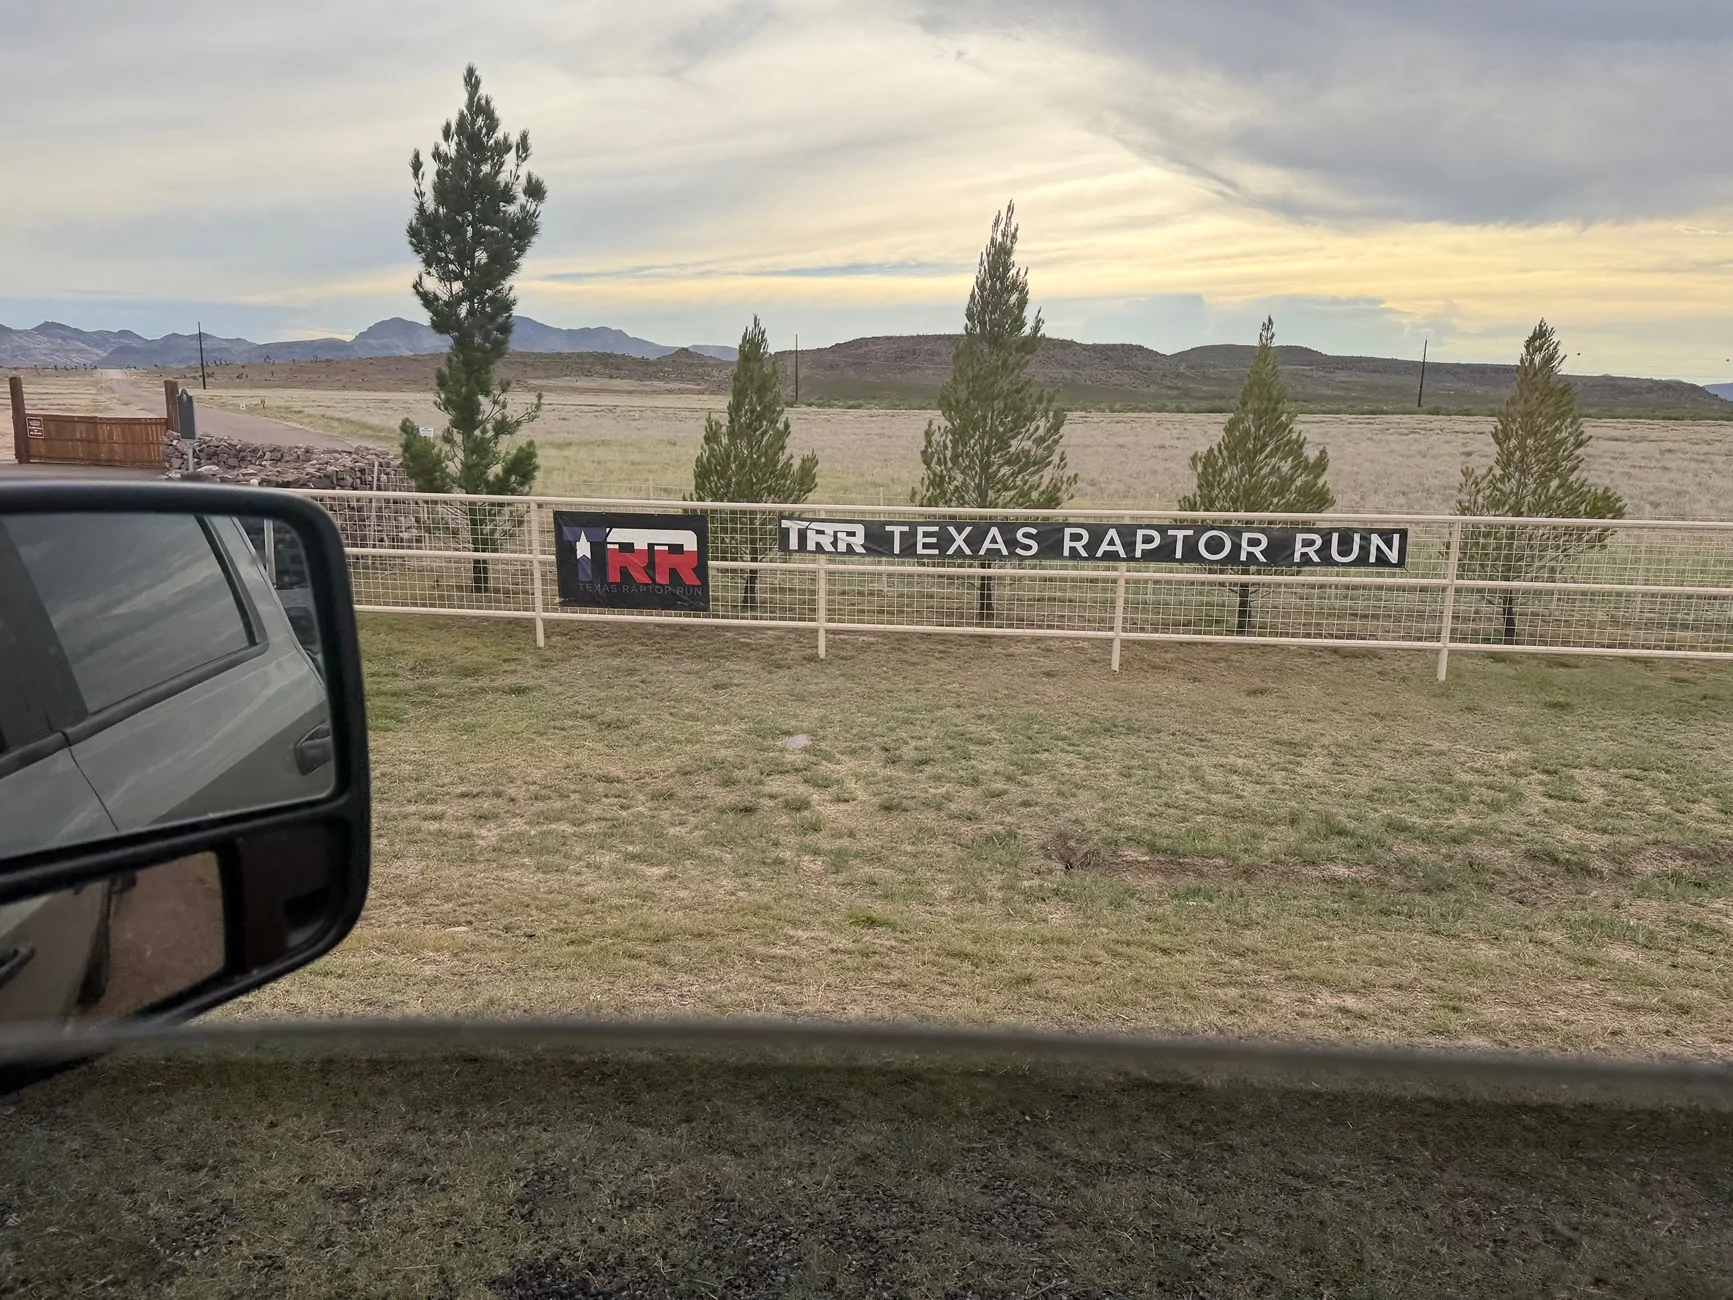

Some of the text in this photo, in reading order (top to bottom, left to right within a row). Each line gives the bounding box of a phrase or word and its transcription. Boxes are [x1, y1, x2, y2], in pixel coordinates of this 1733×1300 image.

[563, 526, 701, 585] TRR
[781, 519, 1400, 564] TRR TEXAS RAPTOR RUN
[579, 583, 702, 596] TEXAS RAPTOR RUN
